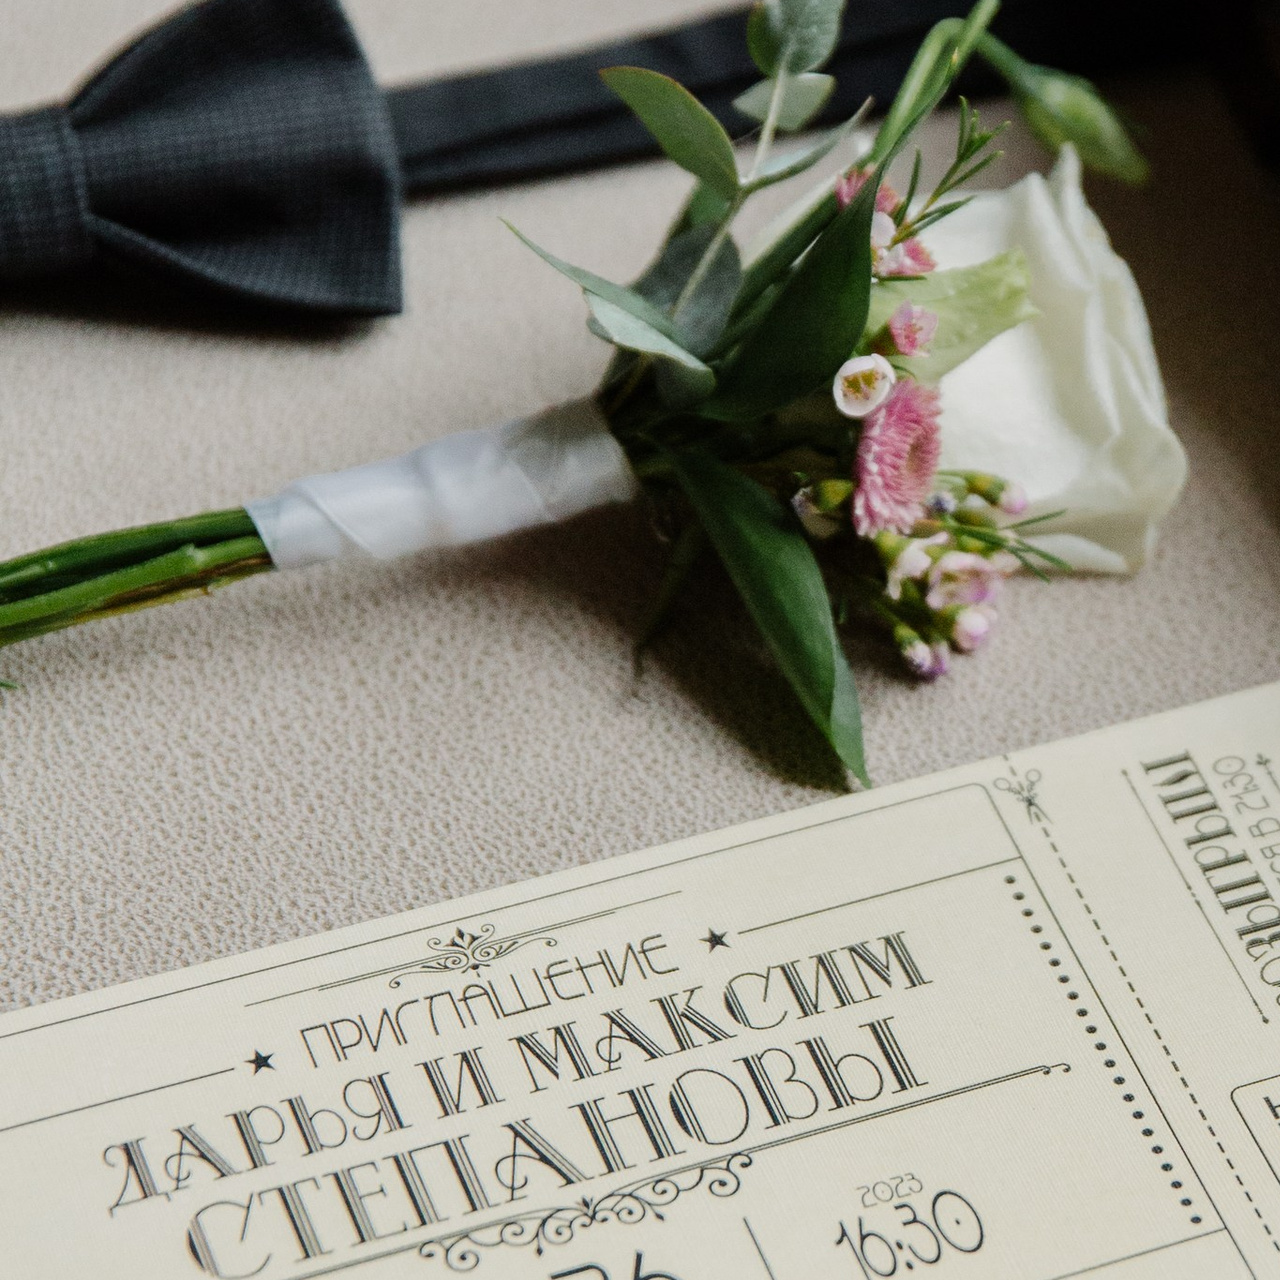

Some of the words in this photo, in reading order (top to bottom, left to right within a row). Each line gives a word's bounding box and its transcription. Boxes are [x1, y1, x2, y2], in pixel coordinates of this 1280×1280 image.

[103, 1072, 412, 1217] ДАРЬЯ
[415, 1046, 506, 1119] И
[508, 930, 933, 1094] МАКСИМ
[300, 933, 680, 1068] ПРИГЛАШЕНИЕ
[185, 1015, 929, 1280] СТЕПАНОВЫ
[856, 1172, 924, 1208] 2023
